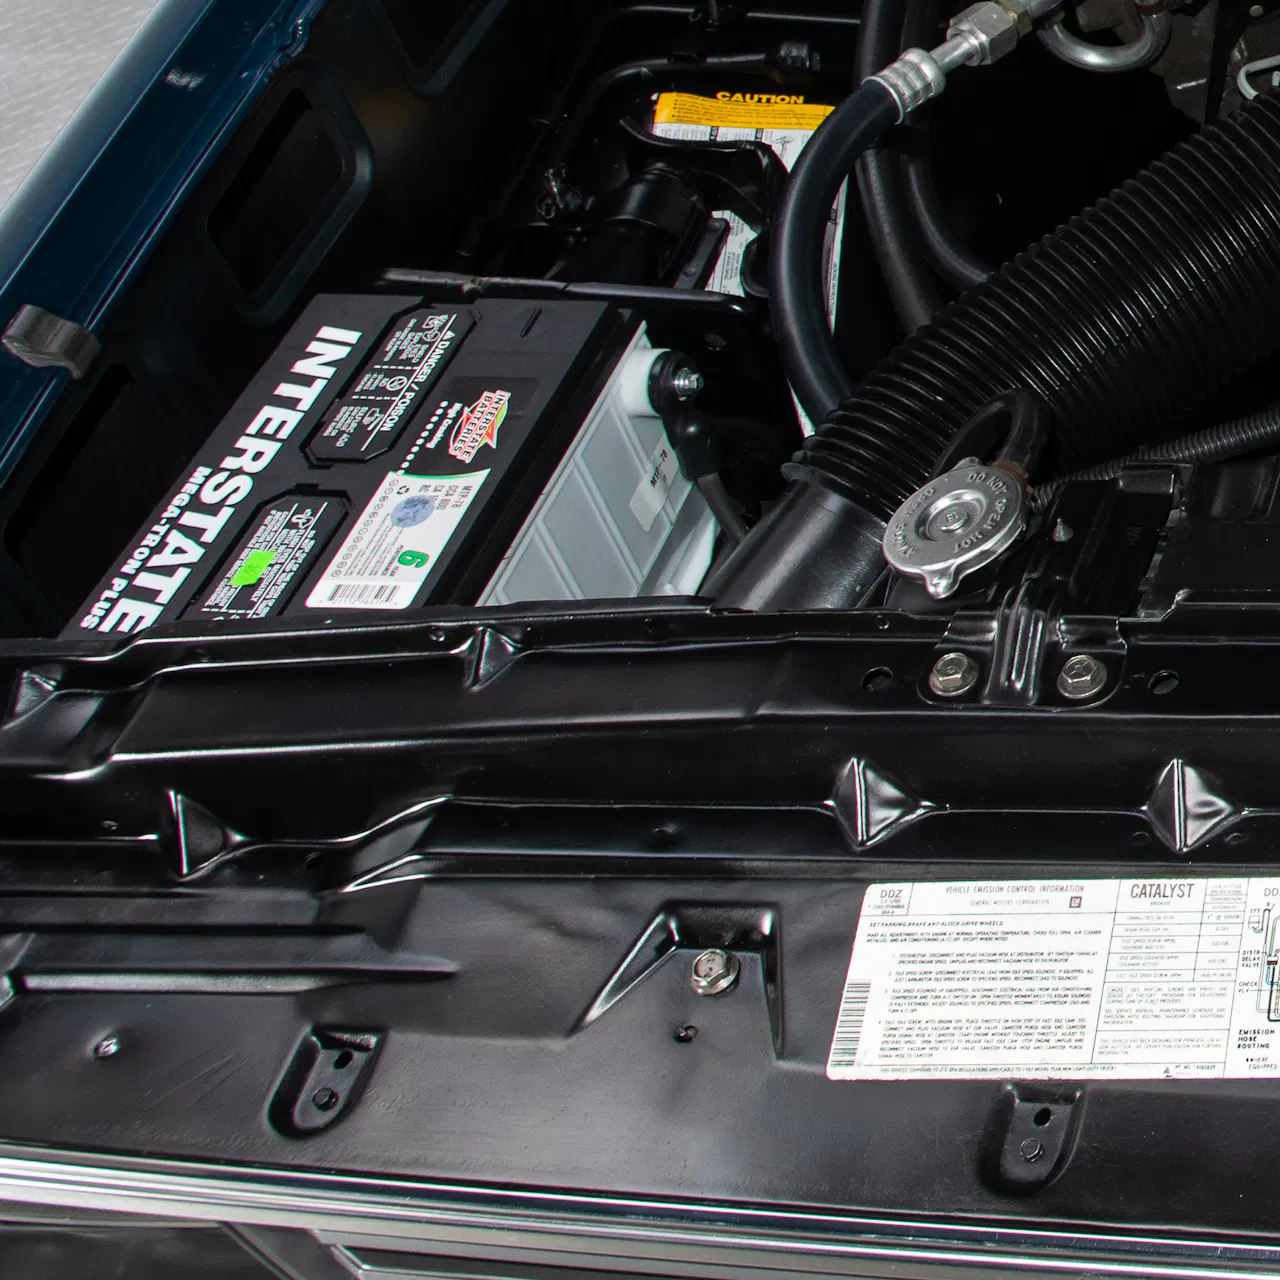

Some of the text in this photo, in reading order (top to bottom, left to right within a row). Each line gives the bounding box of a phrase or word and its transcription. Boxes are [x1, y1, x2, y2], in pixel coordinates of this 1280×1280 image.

[716, 92, 804, 105] CAUTION
[412, 341, 451, 381] DANGER
[379, 392, 416, 430] POISON
[453, 395, 492, 452] BATTERIES
[462, 393, 506, 457] INTERSTATE
[98, 326, 362, 633] INTERSTATE
[967, 471, 986, 483] DO
[986, 476, 1007, 495] NOT
[449, 485, 474, 507] MTP-78
[80, 467, 213, 629] MEGA-TRON PLUS
[397, 549, 430, 568] 6
[945, 884, 1085, 894] VEHICLE EMISSION CONTROL INFORMATION
[1130, 883, 1194, 898] CATALYST
